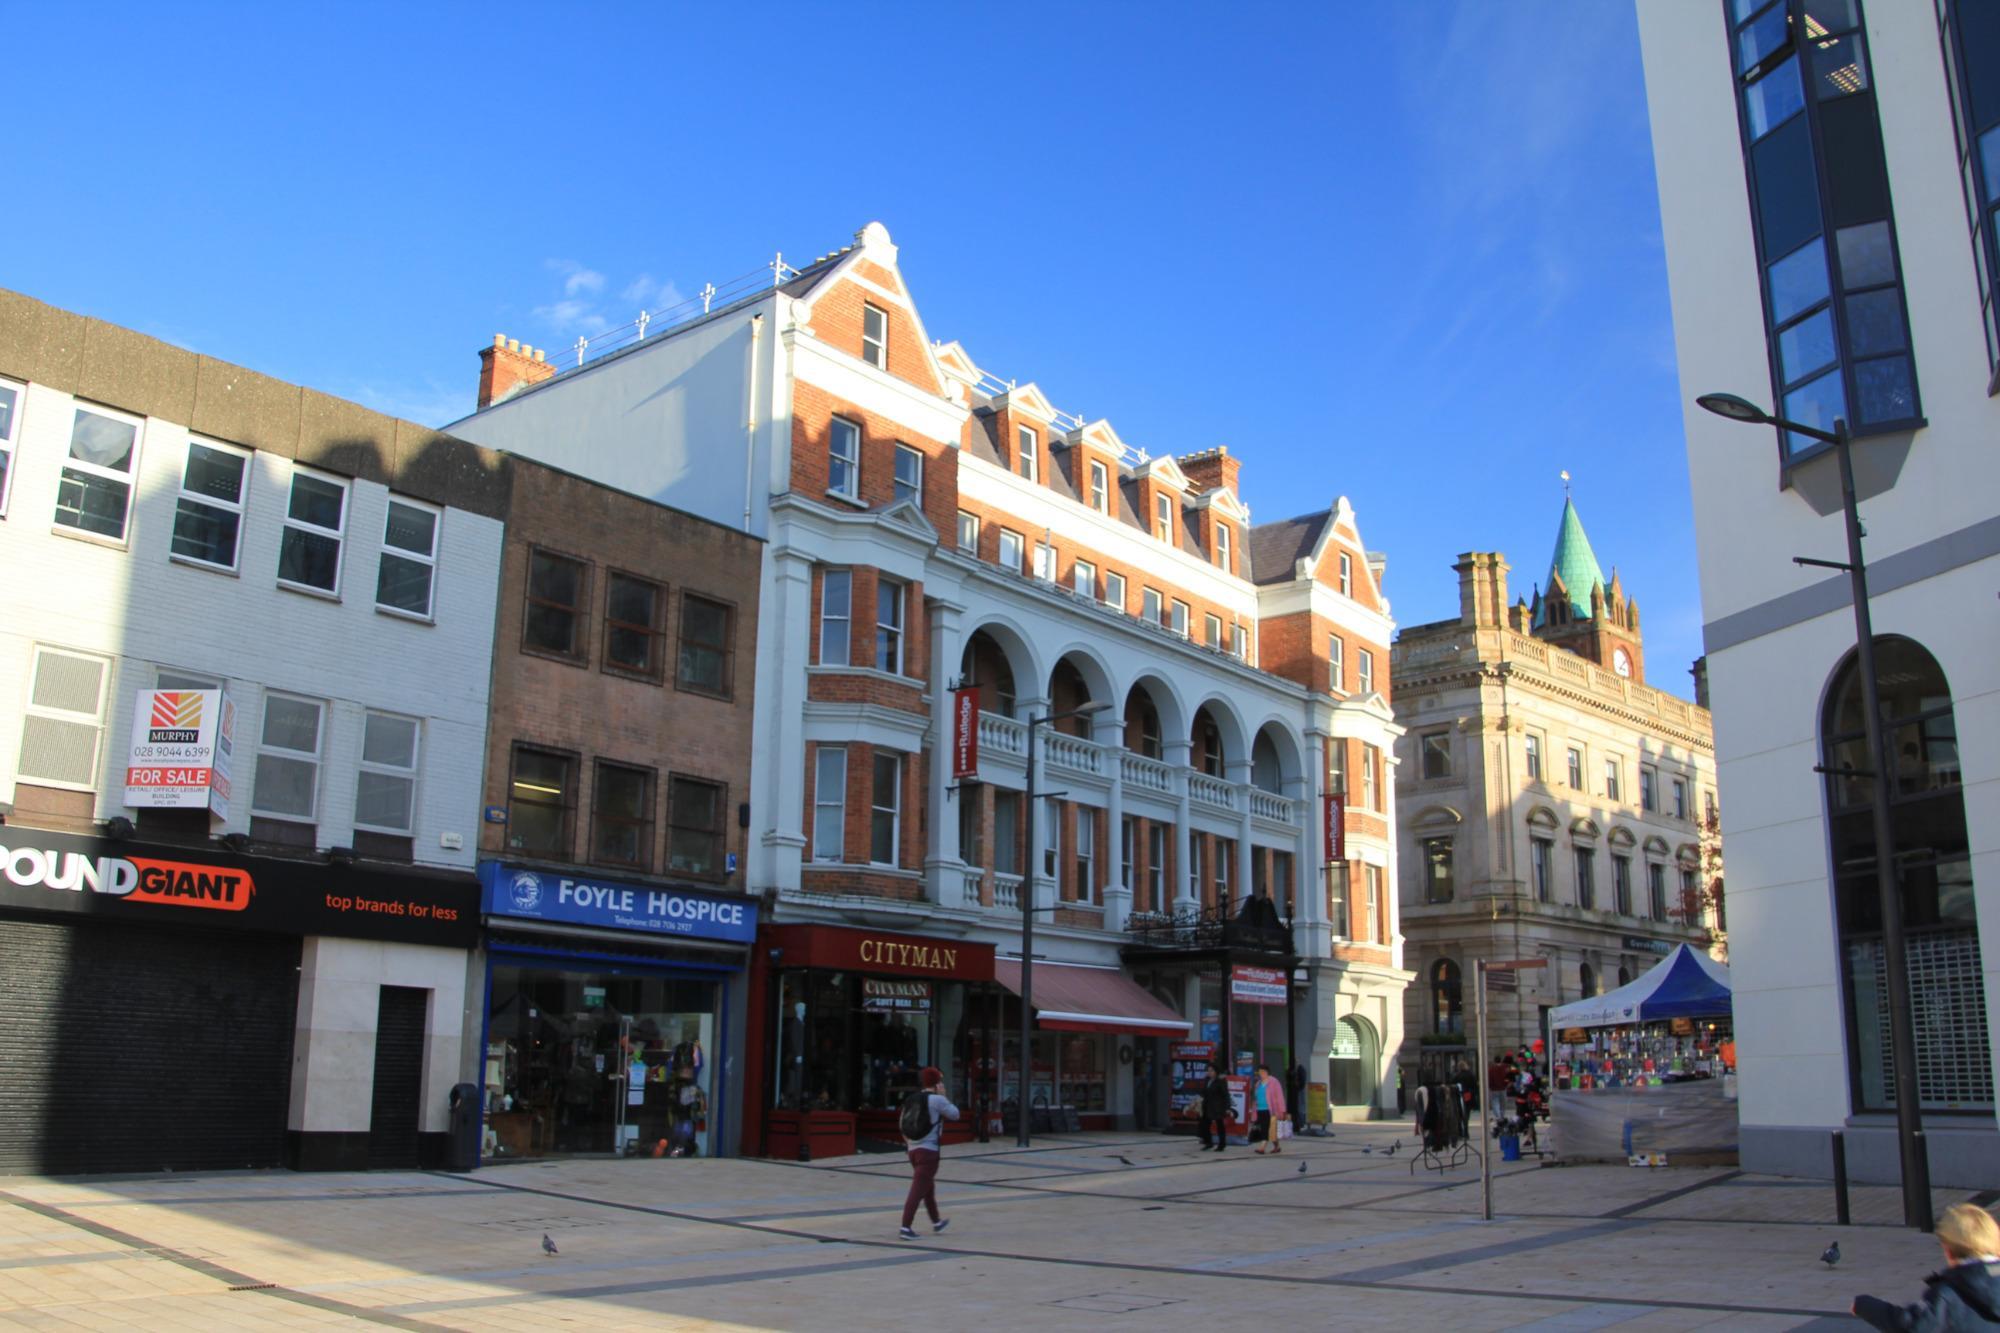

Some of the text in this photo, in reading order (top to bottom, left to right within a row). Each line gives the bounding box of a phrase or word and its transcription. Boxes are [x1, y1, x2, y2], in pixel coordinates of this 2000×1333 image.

[959, 696, 971, 747] Rutledge
[152, 731, 197, 741] MURPHY
[134, 747, 210, 757] 028 9044 6399
[131, 769, 161, 784] FOR
[167, 770, 207, 784] SALE
[326, 894, 458, 920] top brands for less
[558, 879, 743, 925] FOYLE HOSPICE
[860, 940, 957, 970] CITYMAN
[865, 980, 929, 996] CITYMAN
